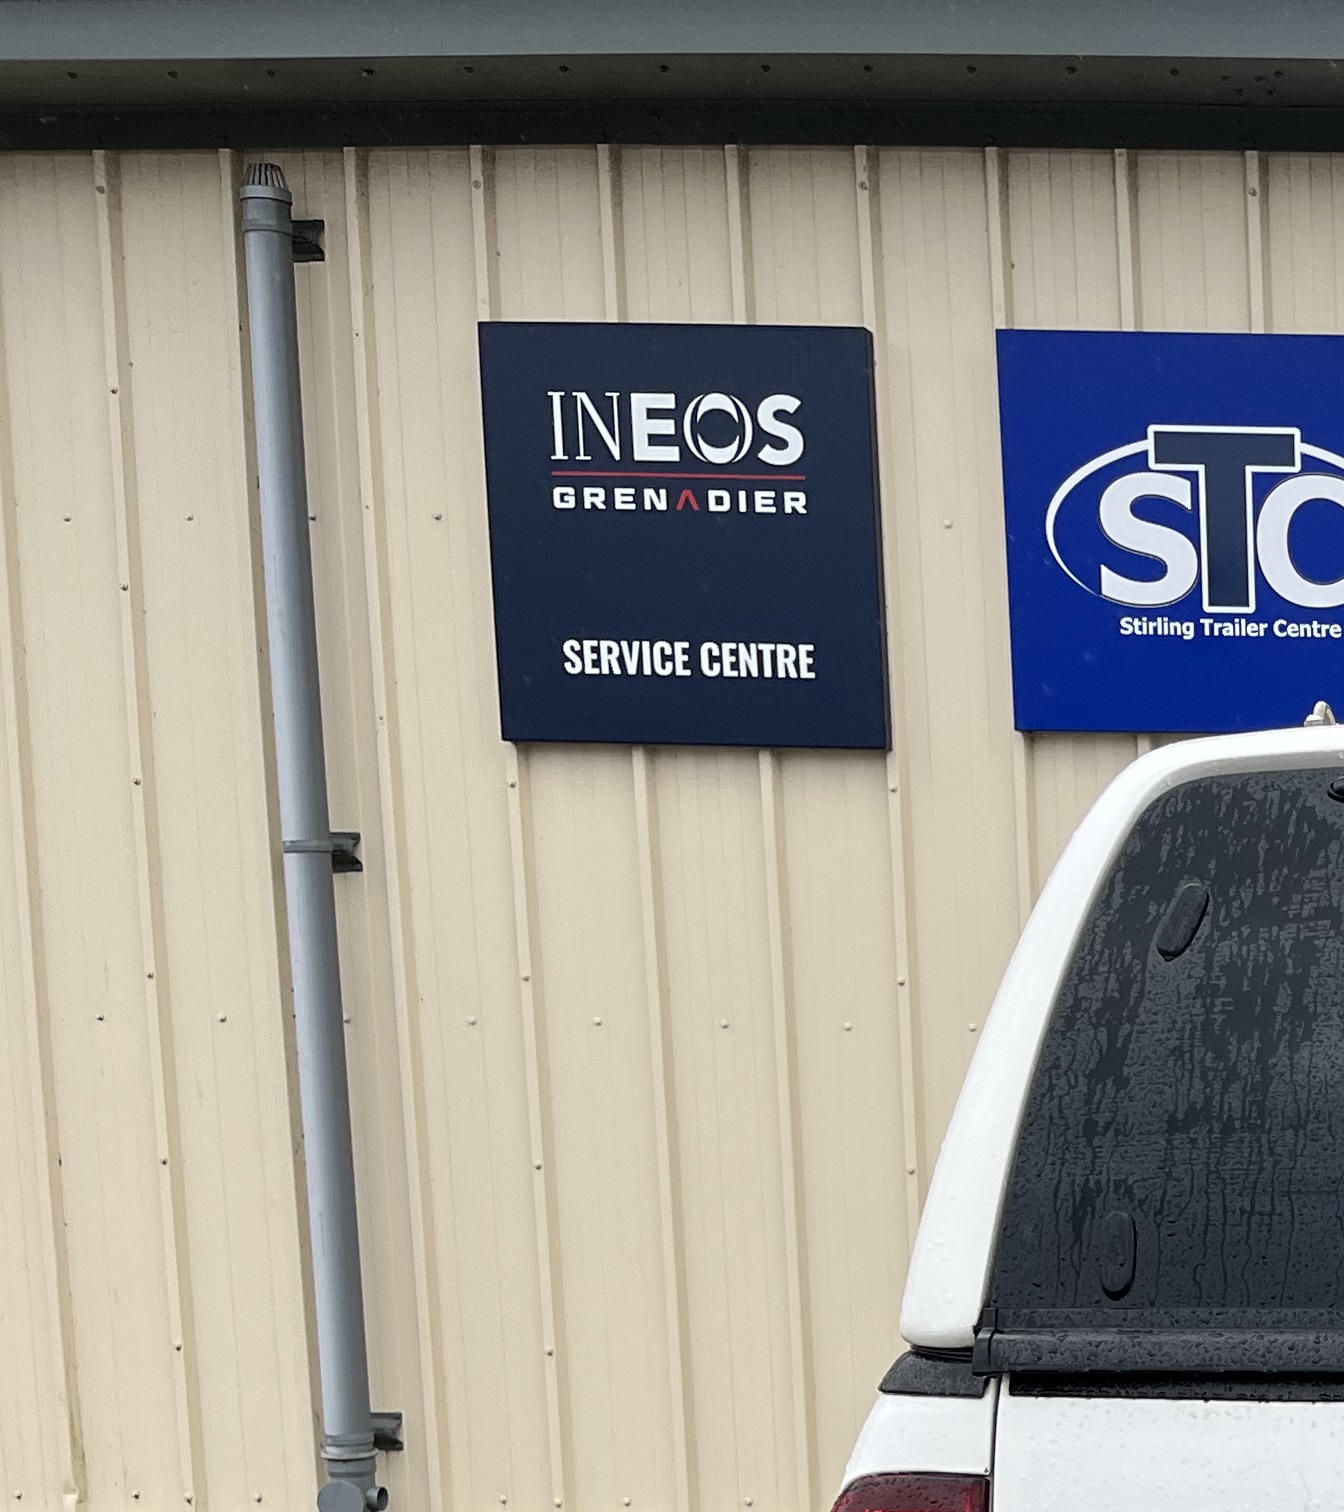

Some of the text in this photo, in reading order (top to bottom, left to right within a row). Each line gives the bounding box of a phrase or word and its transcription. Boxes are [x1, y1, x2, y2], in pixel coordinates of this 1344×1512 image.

[547, 391, 805, 466] INEOS
[552, 485, 808, 514] GRENADIER
[1119, 616, 1342, 640] Stirling Trailer Centre
[562, 639, 816, 679] SERVICE CENTRE
